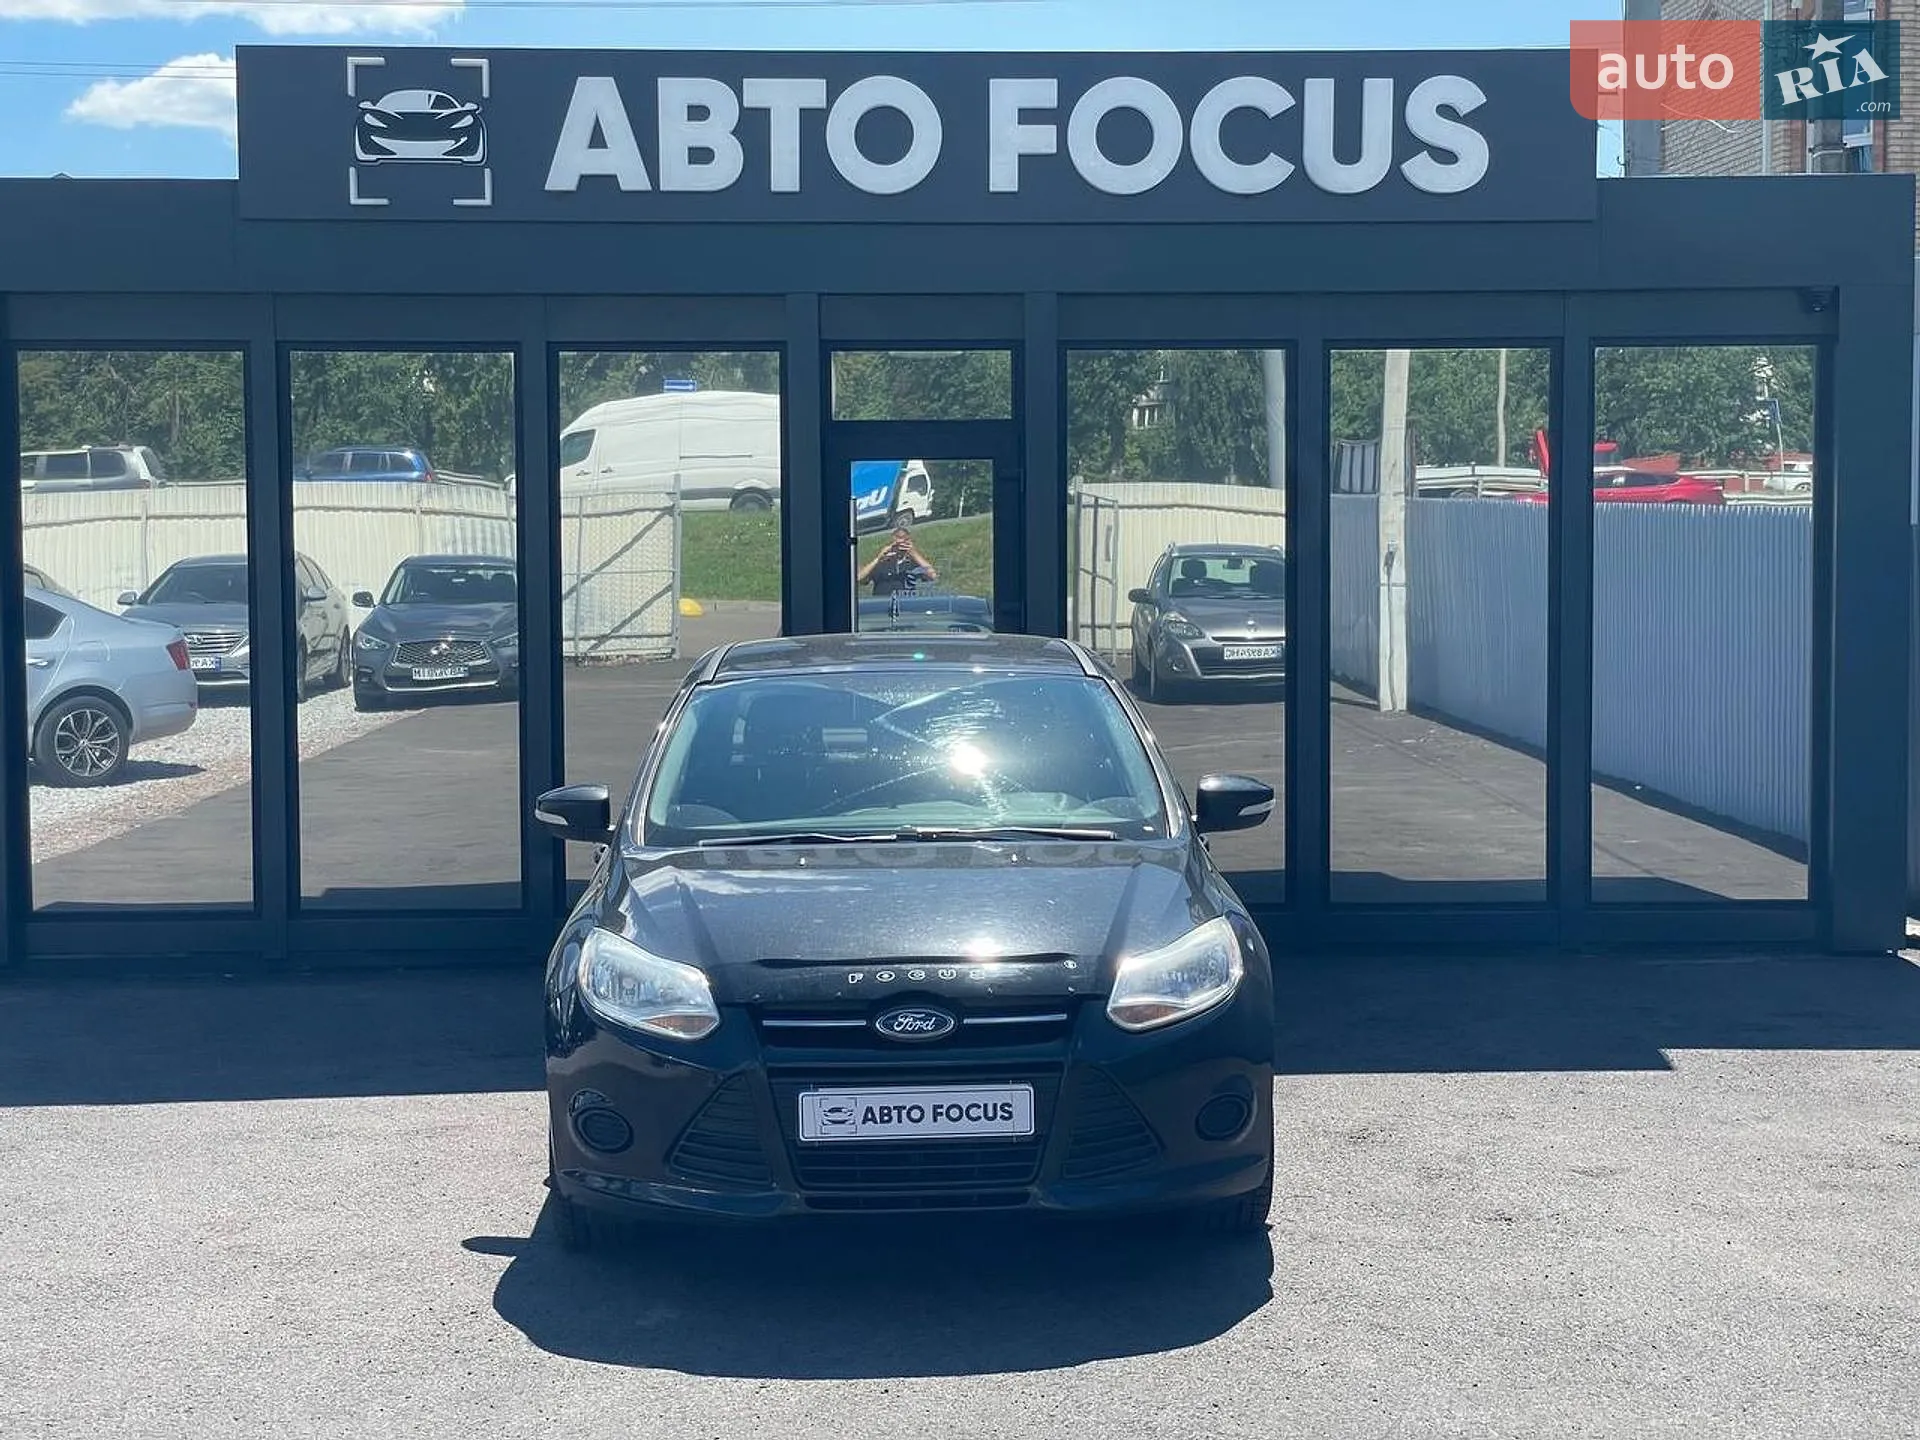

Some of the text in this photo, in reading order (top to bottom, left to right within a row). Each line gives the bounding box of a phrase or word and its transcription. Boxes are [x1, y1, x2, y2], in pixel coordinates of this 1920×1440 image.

[544, 74, 1490, 196] АВТО FOCUS
[893, 1013, 936, 1031] Ford
[861, 1102, 1014, 1125] АВТО FOCUS
